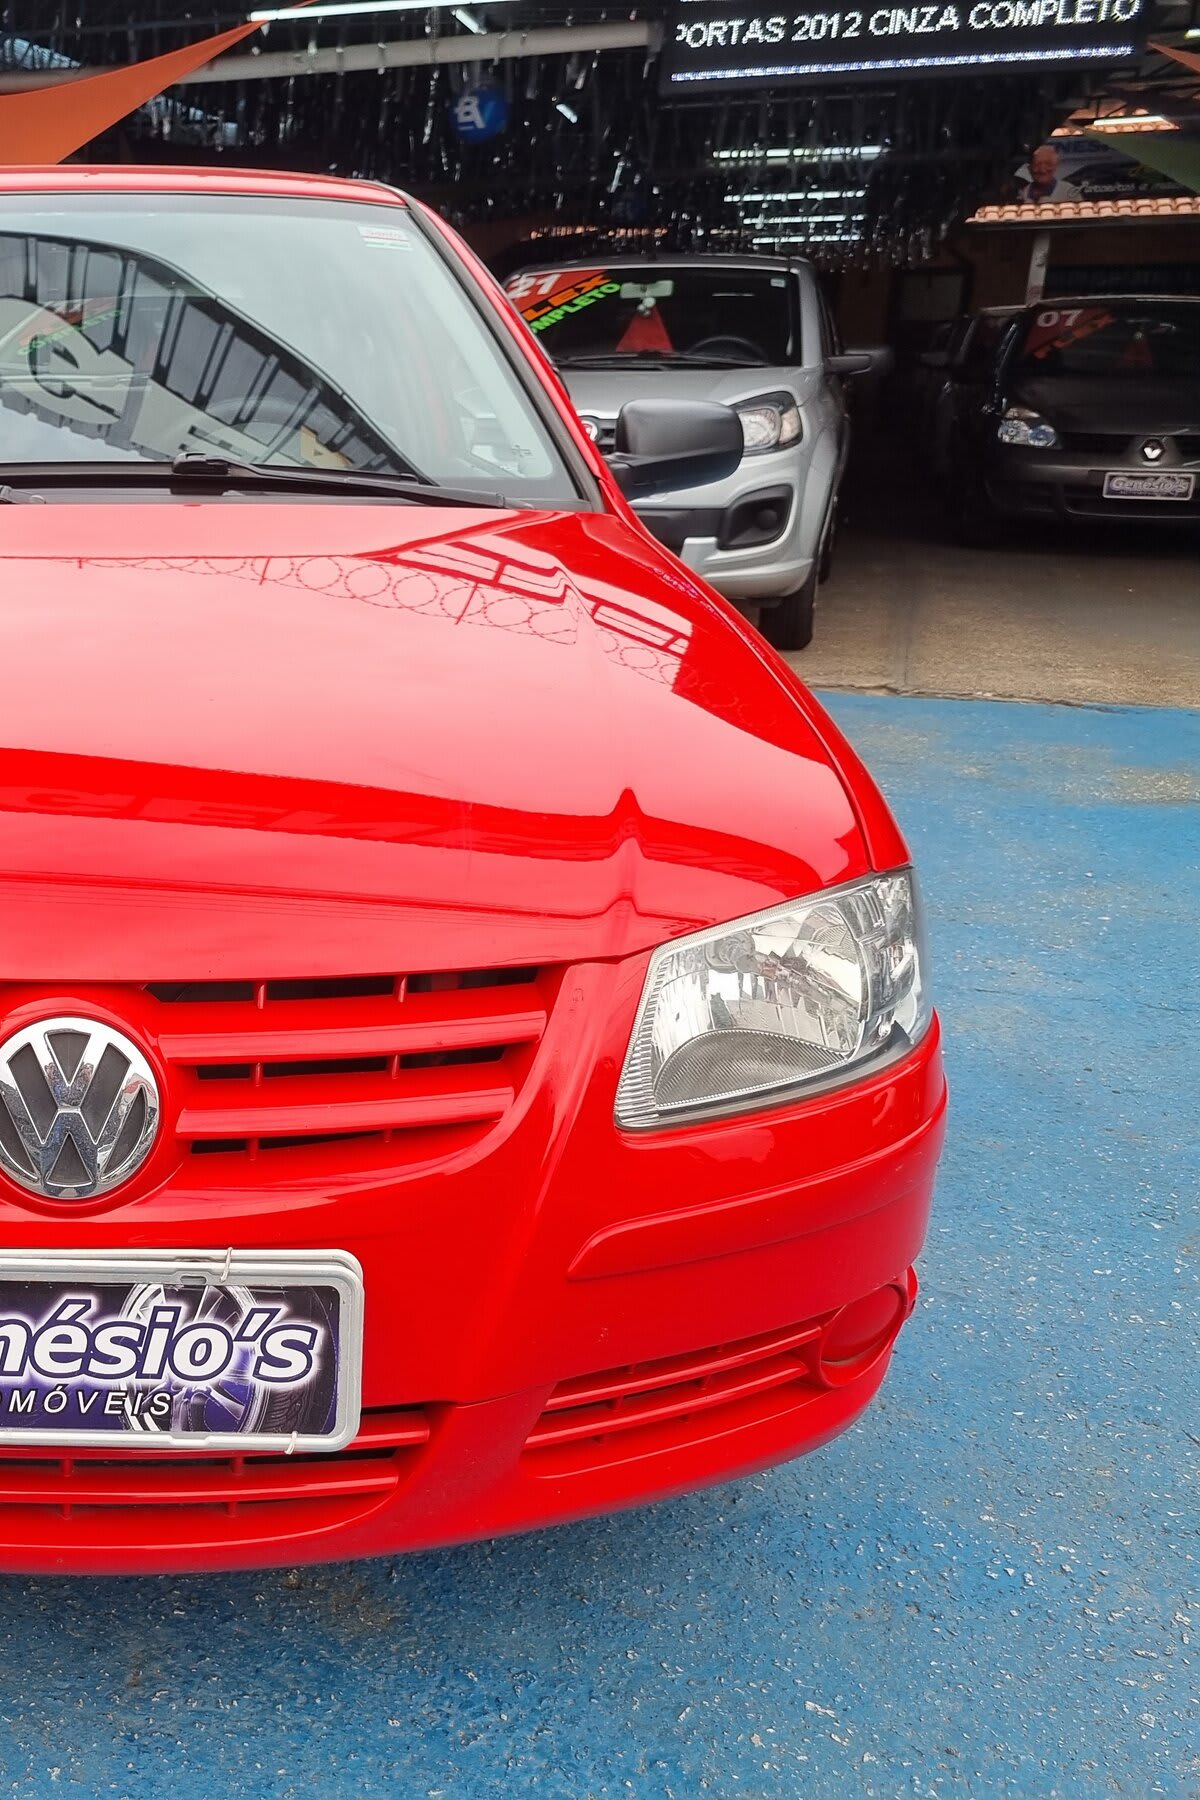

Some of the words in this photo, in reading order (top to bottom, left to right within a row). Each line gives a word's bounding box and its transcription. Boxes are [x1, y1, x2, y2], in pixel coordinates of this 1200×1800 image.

[791, 12, 863, 42] 2012
[869, 6, 960, 36] CINZA
[968, 0, 1142, 30] COMPLETO
[521, 274, 612, 322] LEX
[1036, 308, 1084, 328] 07
